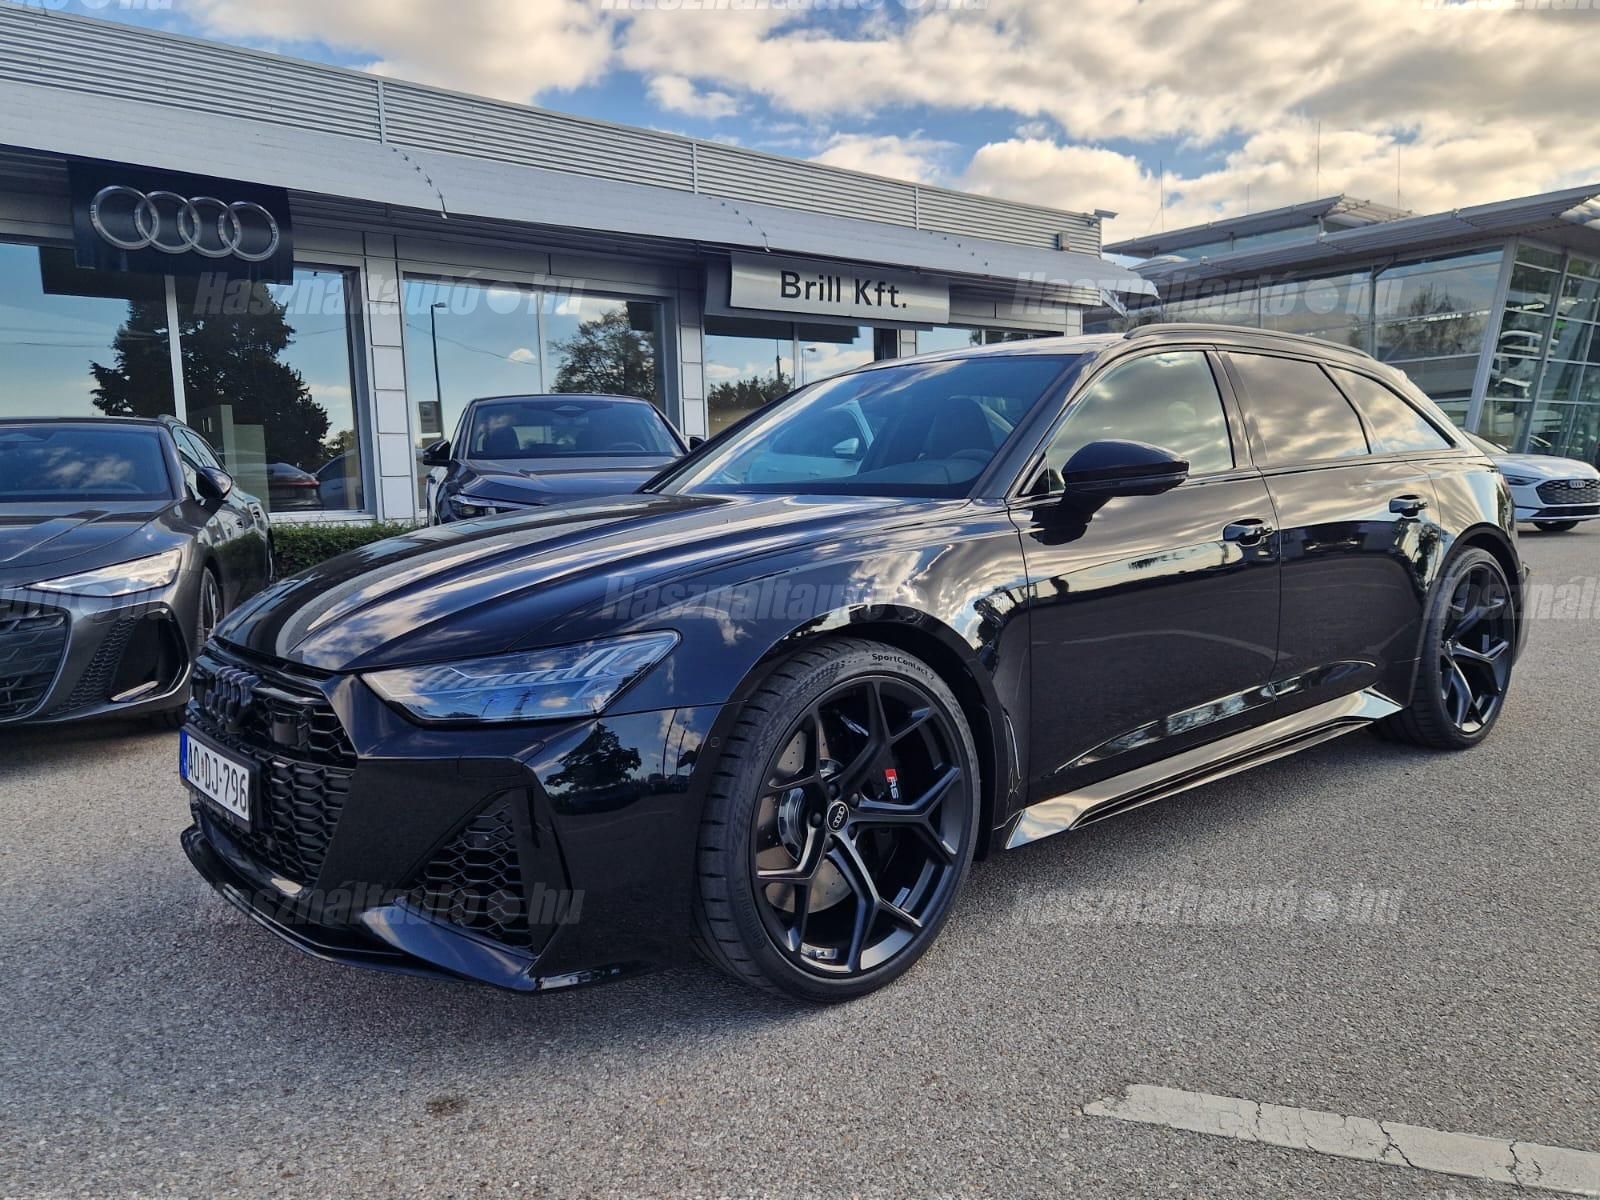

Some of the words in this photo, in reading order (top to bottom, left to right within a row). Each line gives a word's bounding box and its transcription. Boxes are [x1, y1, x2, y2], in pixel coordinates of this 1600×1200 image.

[781, 270, 841, 303] Brill
[855, 278, 907, 309] Kft.
[871, 653, 928, 676] SportContact
